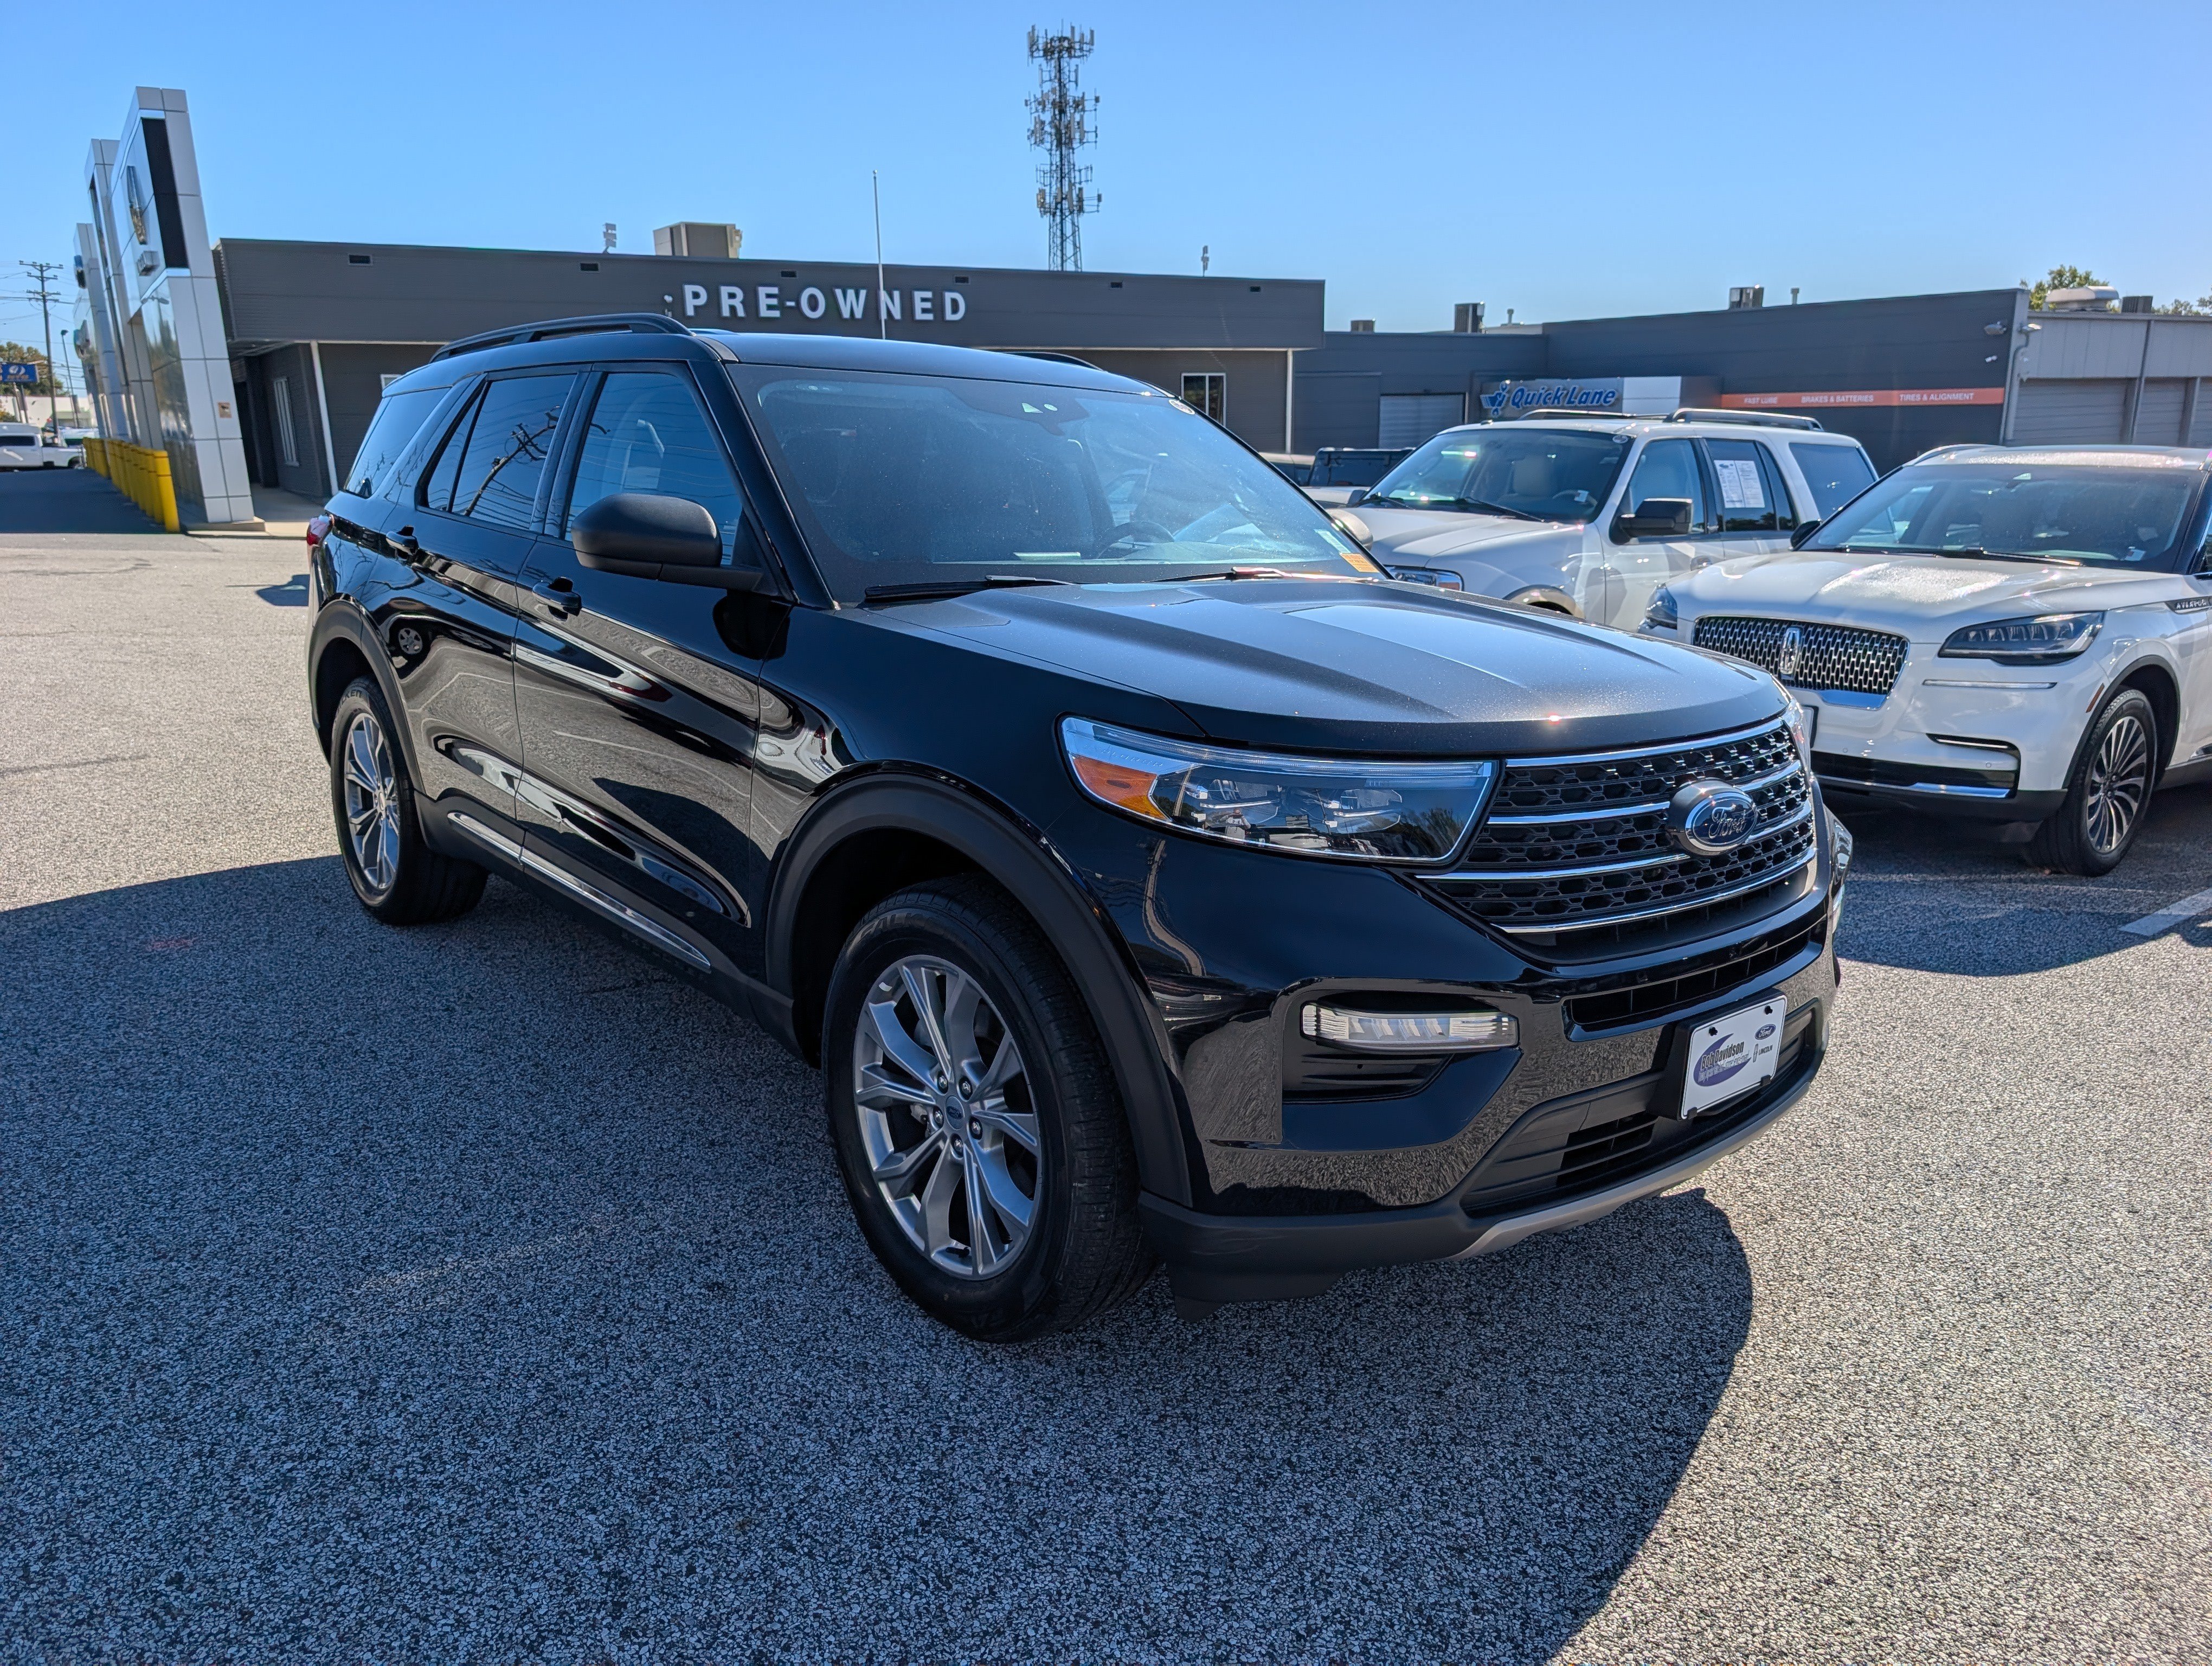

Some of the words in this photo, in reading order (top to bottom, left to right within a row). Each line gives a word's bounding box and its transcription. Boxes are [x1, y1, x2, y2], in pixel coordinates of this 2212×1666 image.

[683, 284, 967, 321] PRE-OWNED
[1510, 386, 1566, 409] Quick
[1566, 385, 1618, 406] Lane
[1928, 392, 1974, 400] ALIGNMENT
[1708, 805, 1747, 840] Ford
[1700, 1052, 1715, 1070] Bob
[1714, 1041, 1745, 1064] Davidson
[1758, 1044, 1773, 1055] LINCOLN
